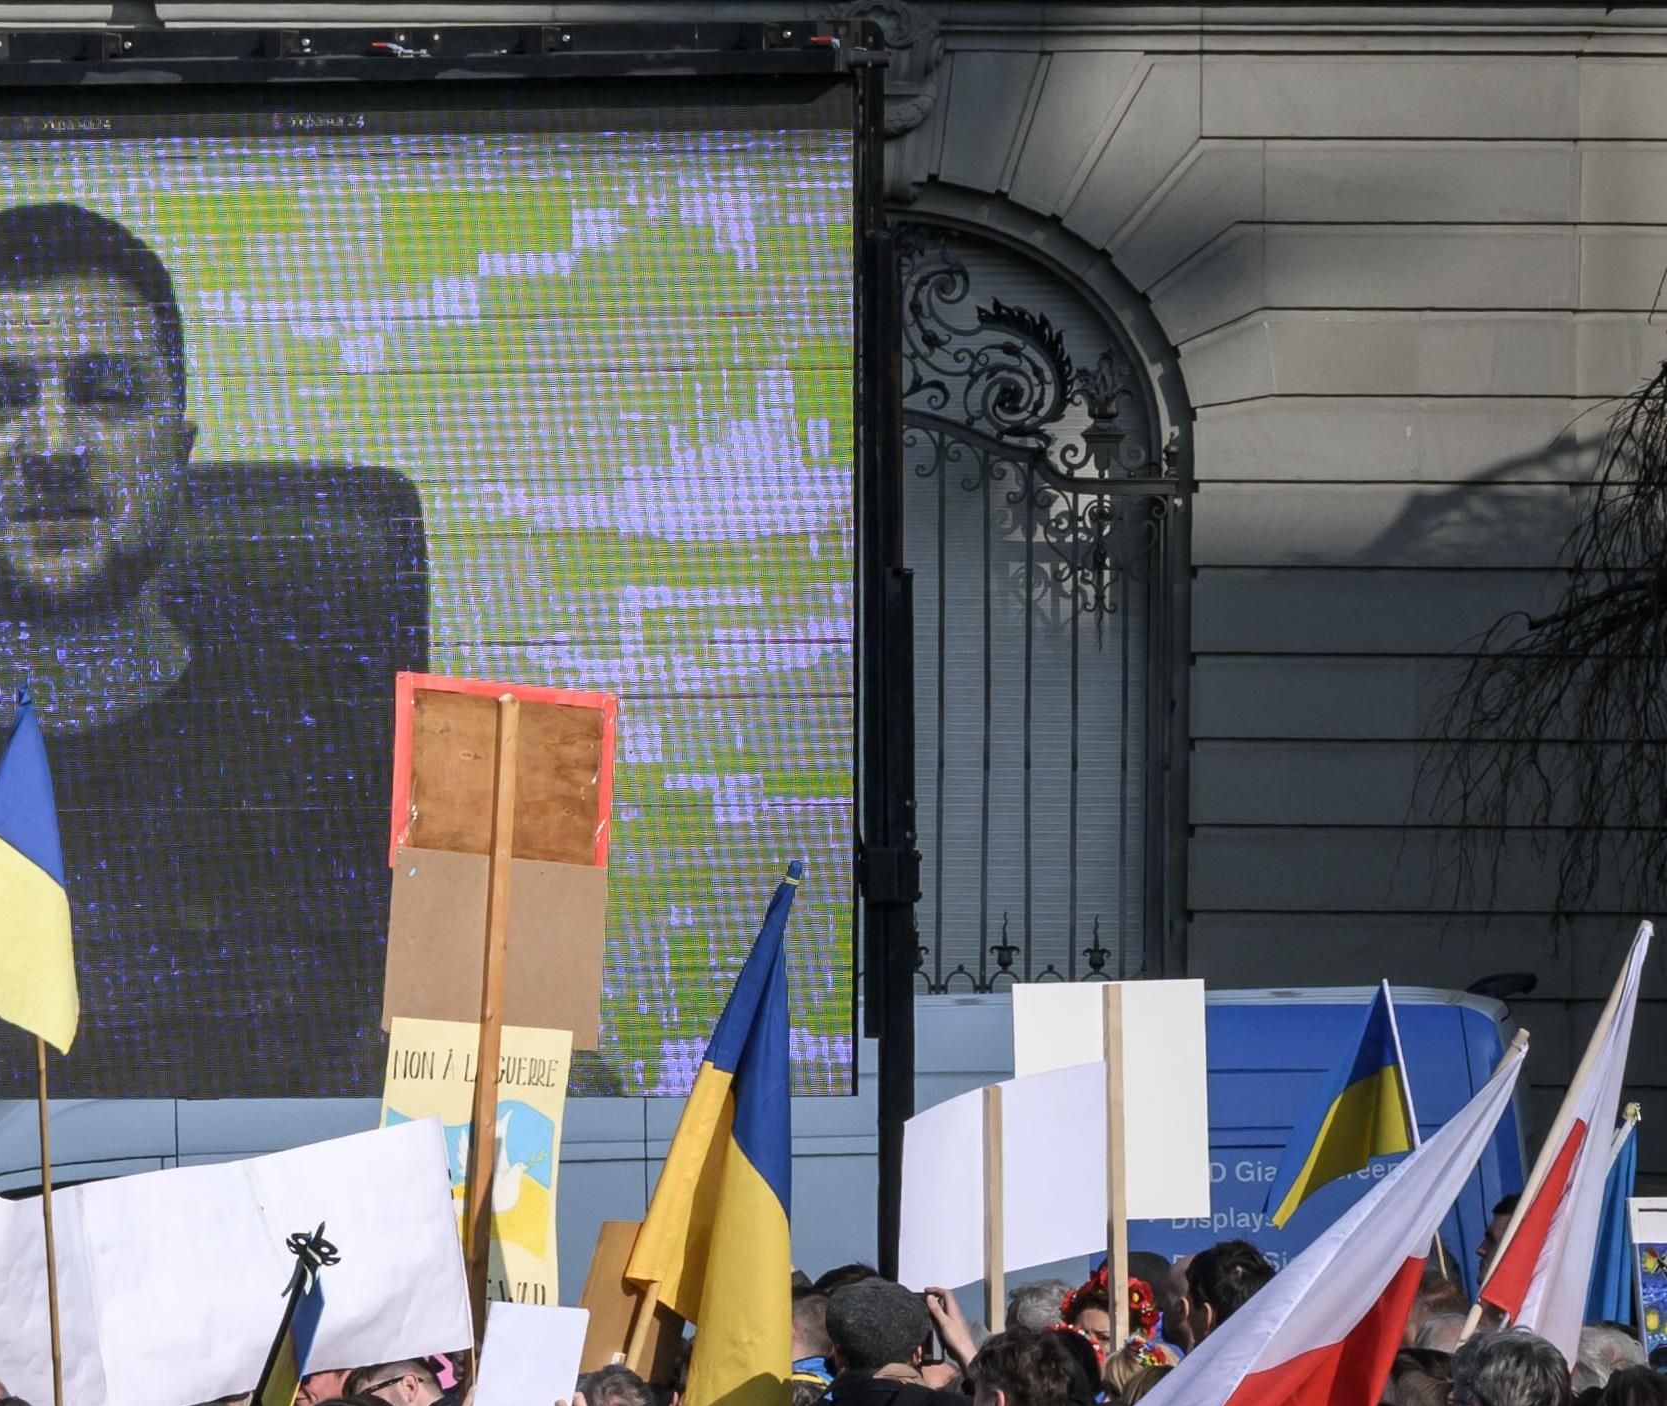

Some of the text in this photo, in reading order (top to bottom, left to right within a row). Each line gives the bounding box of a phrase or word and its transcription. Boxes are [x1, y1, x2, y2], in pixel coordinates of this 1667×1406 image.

[393, 1050, 435, 1080] NON
[464, 1053, 479, 1083] L
[496, 1055, 560, 1088] GUERRE
[1235, 1160, 1277, 1183] Gia
